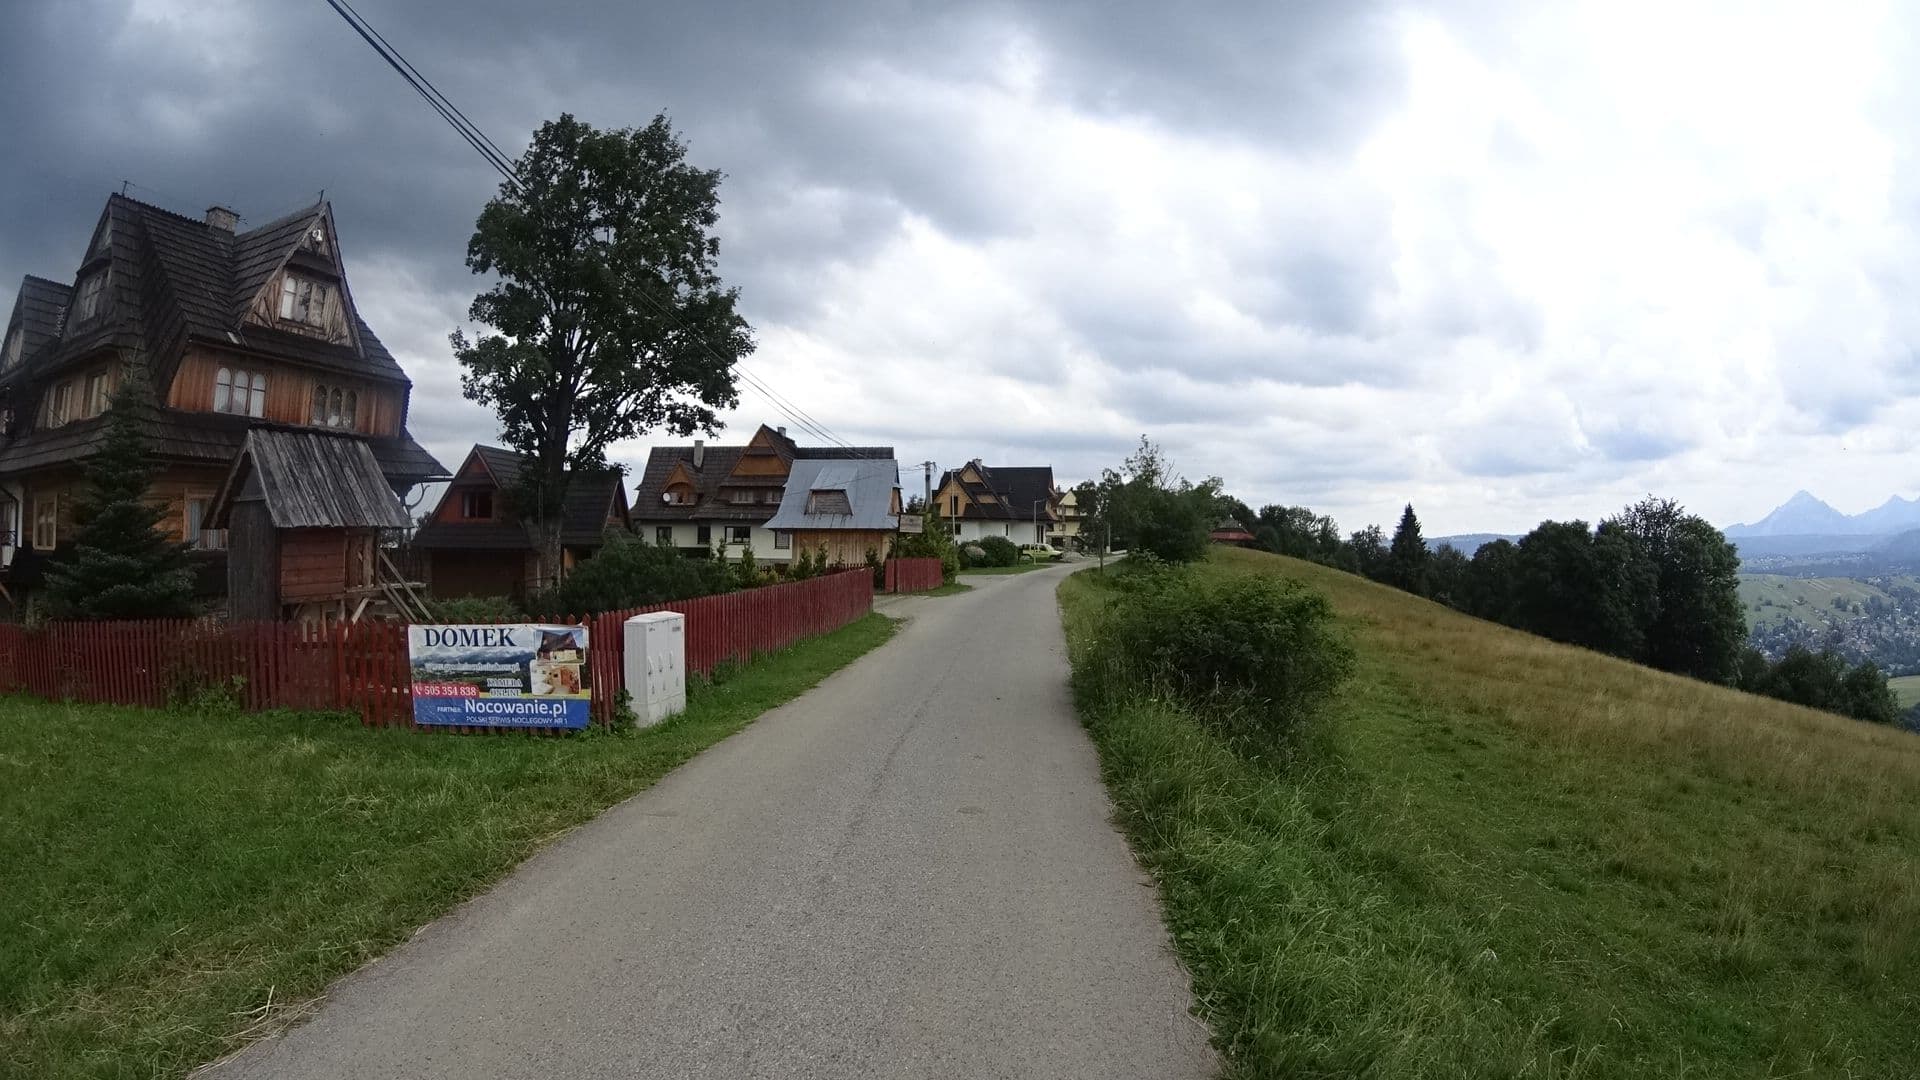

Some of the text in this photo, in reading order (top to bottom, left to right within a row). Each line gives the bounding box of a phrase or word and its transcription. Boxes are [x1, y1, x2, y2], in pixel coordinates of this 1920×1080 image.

[424, 628, 518, 647] DOMEK
[425, 686, 476, 696] 505 354 838
[489, 688, 522, 697] ONLINE
[465, 699, 567, 717] Nocowanie.pl
[512, 717, 553, 725] NOCLEGOWY
